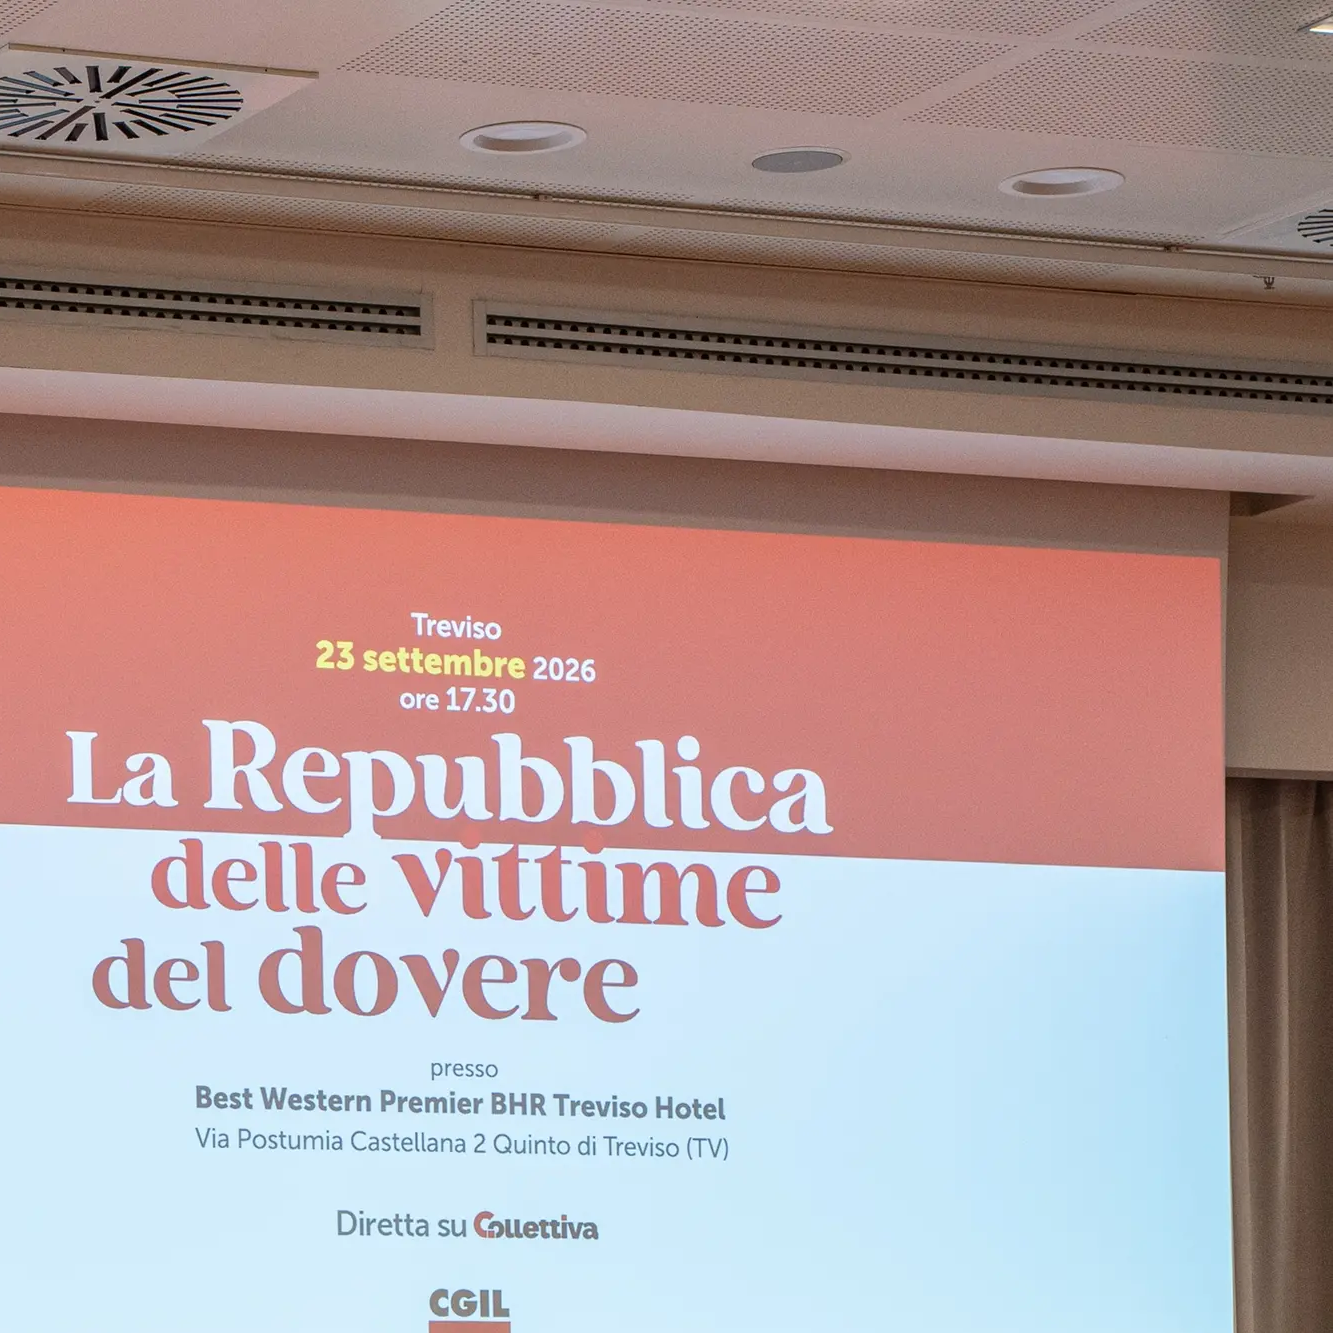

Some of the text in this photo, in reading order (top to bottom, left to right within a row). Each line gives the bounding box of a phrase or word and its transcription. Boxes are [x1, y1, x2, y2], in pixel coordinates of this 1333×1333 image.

[411, 612, 502, 640] Treviso
[316, 640, 596, 682] 23 settembre 2026
[399, 686, 516, 714] ore 17.30
[65, 719, 834, 839] La Repubblica
[151, 829, 783, 929] delle vittime
[92, 925, 640, 1023] del dovere
[431, 1062, 498, 1081] presso
[196, 1085, 726, 1120] Best Western Premier BHR Treviso Hotel
[195, 1127, 729, 1161] Via Postumia Castellana 2 Quinto di Treviso (TV)
[337, 1210, 599, 1240] Diretta su Collettiva
[429, 1288, 510, 1318] CGIL
